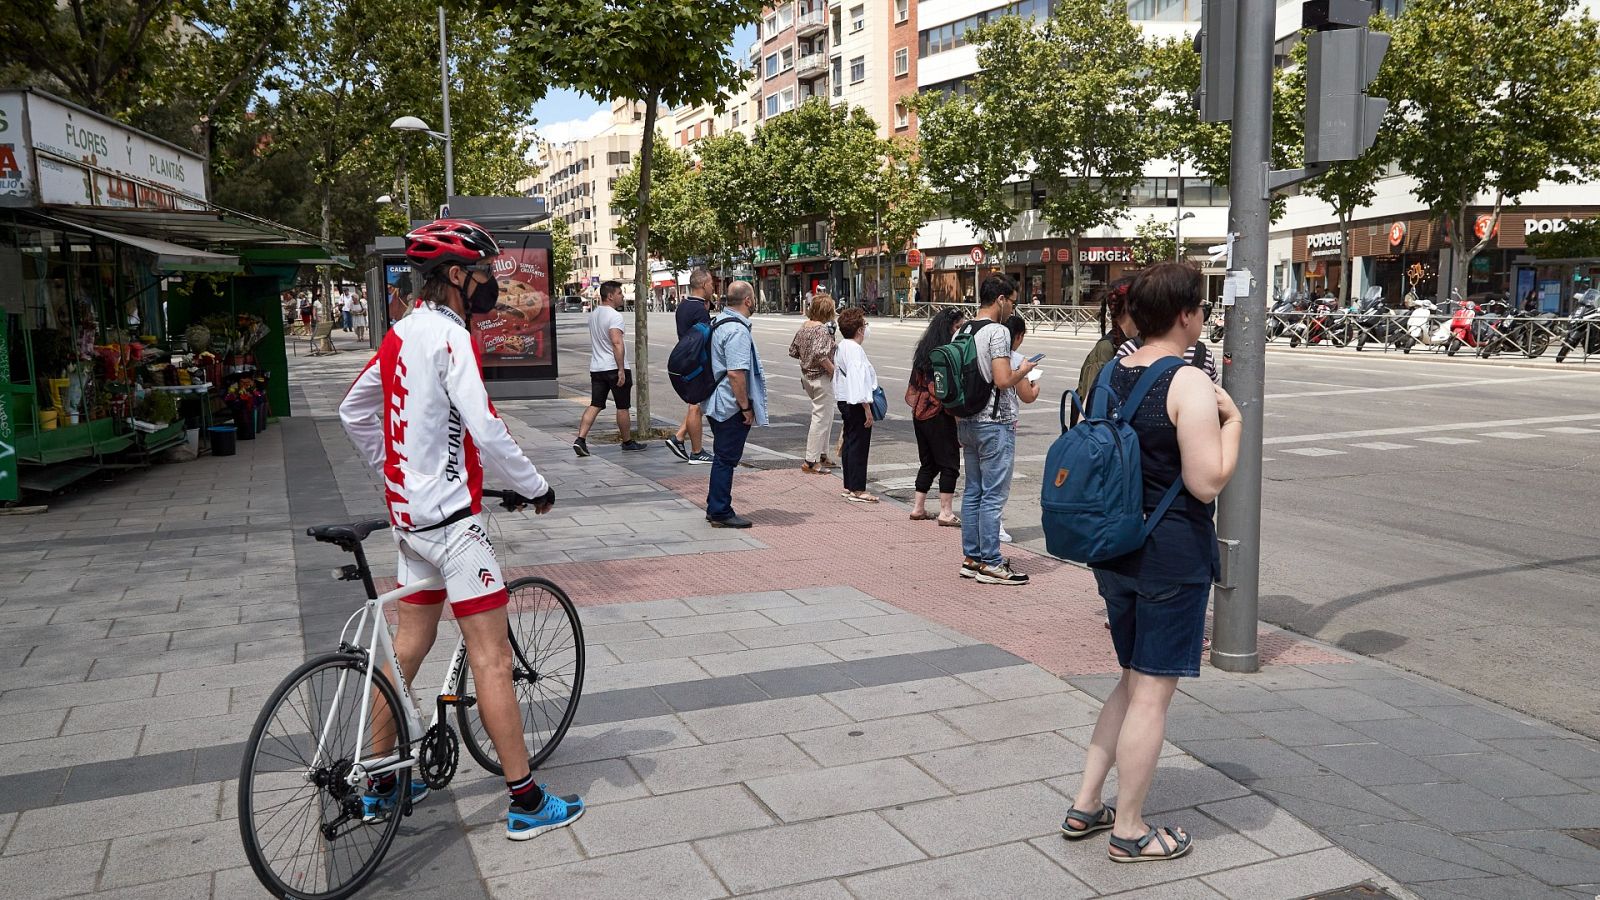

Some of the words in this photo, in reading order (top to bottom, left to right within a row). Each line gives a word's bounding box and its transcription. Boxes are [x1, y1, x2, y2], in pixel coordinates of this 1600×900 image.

[65, 122, 108, 157] FLORES
[126, 145, 132, 165] Y
[149, 153, 185, 182] PLANTAS
[1307, 230, 1349, 249] POPEYE
